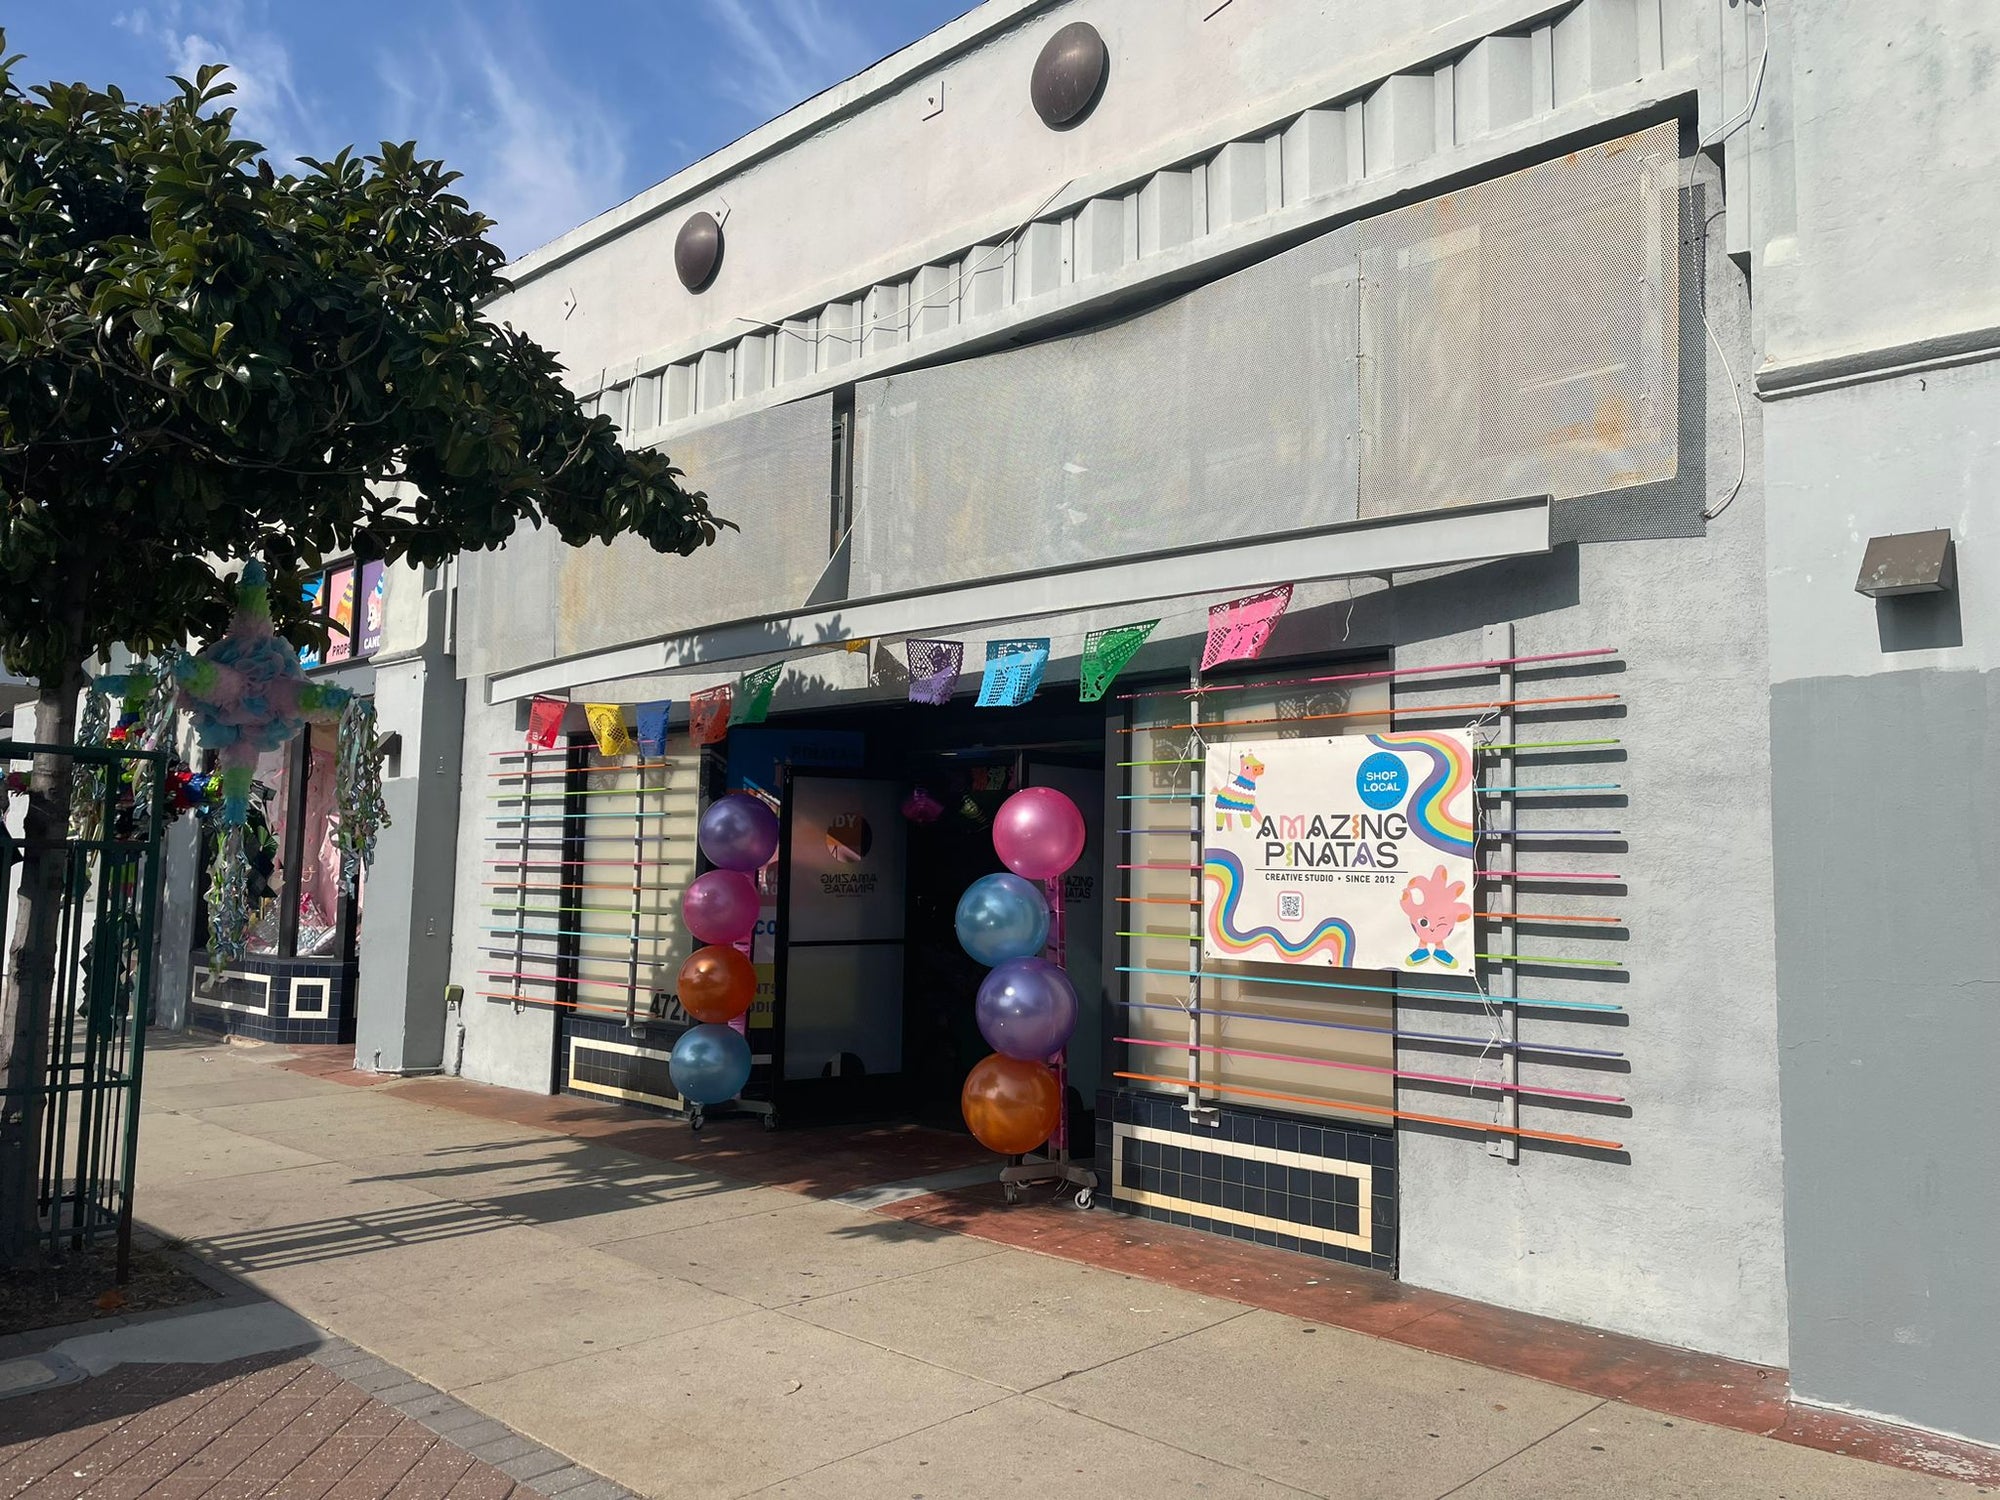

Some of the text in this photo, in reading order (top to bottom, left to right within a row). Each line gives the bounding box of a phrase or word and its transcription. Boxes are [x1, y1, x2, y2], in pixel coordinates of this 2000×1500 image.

[1366, 771, 1398, 781] SHOP
[1363, 782, 1401, 793] LOCAL
[1256, 813, 1408, 840] AMAZING
[1265, 841, 1399, 868] PINATAS
[1265, 873, 1396, 884] CREATIVE STUDIO SINCE 2012
[1065, 887, 1091, 899] ATAS
